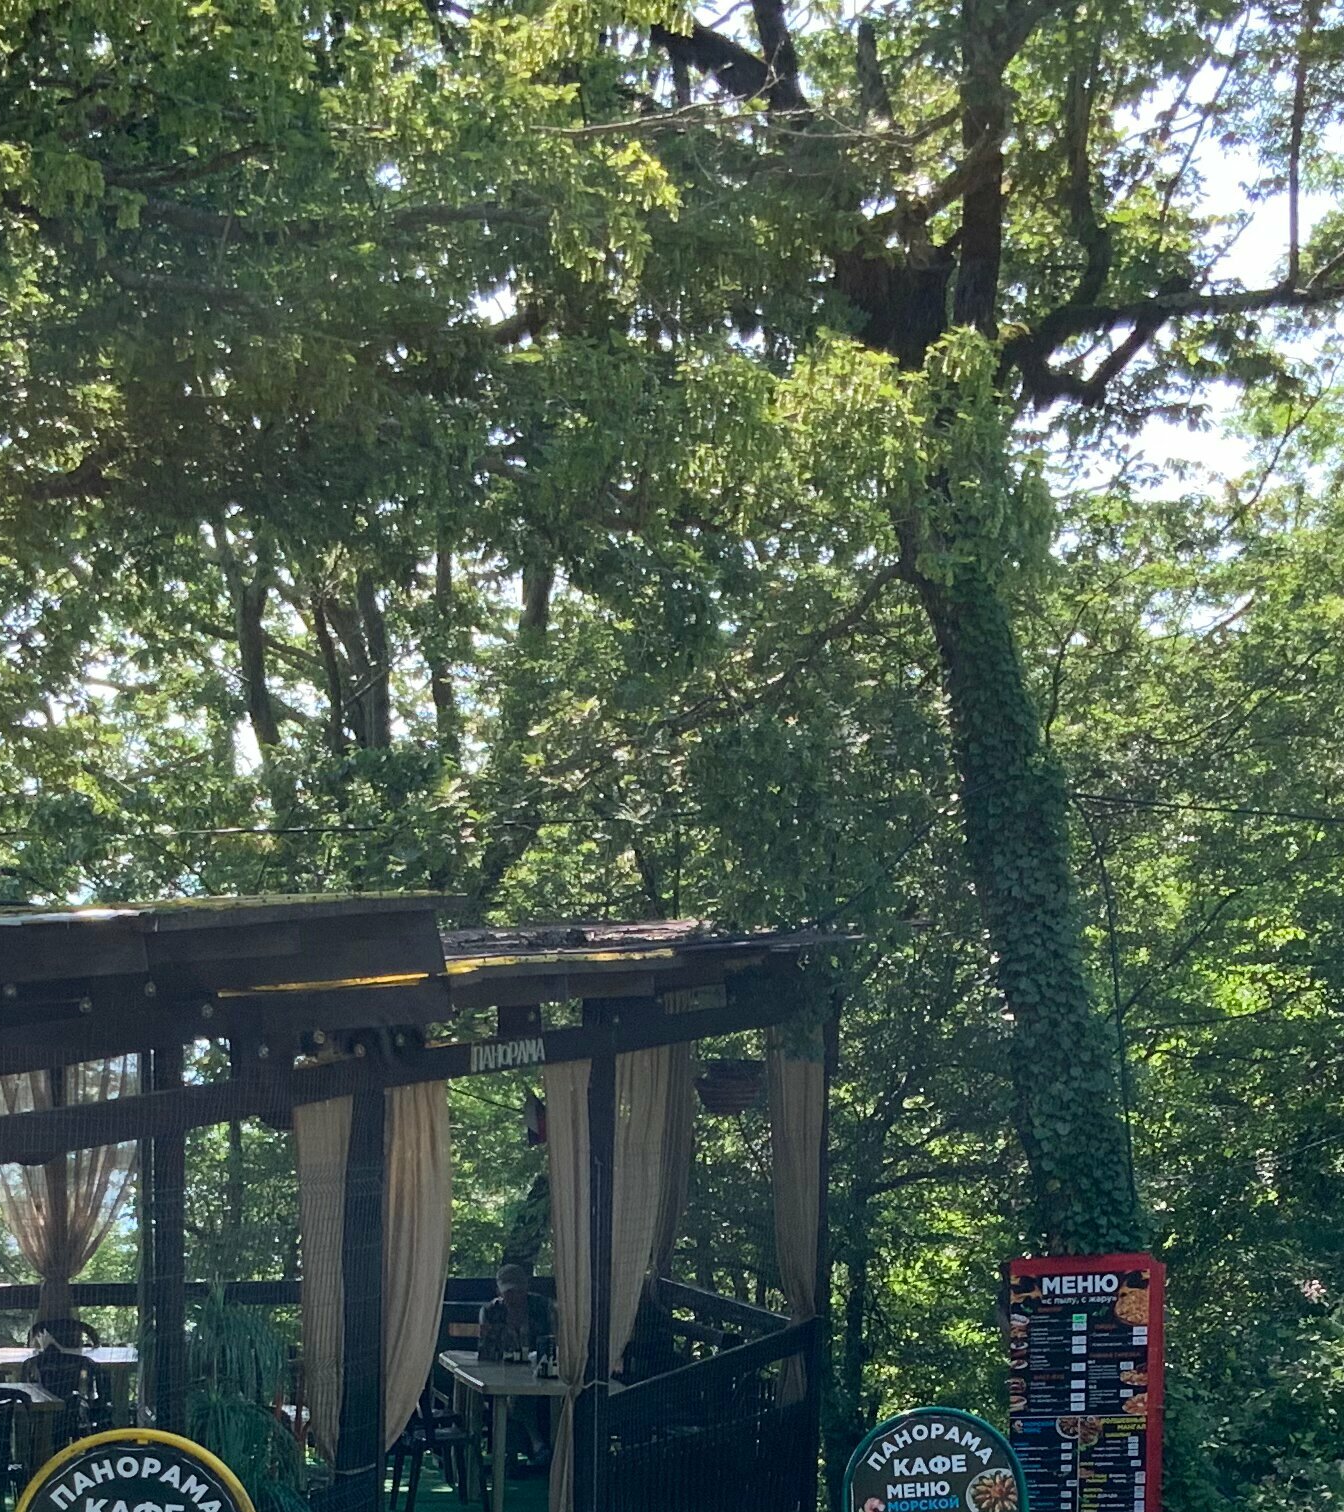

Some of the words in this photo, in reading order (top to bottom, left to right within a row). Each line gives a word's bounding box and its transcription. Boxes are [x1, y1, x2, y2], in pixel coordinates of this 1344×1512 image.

[471, 1038, 545, 1072] ПАНОРАМА
[1042, 1274, 1118, 1295] МЕНЮ
[867, 1423, 993, 1471] ПАНОРАМА
[893, 1454, 967, 1477] КАФЕ
[887, 1481, 950, 1499] МЕНЮ
[888, 1495, 959, 1512] МОРСКОЙ
